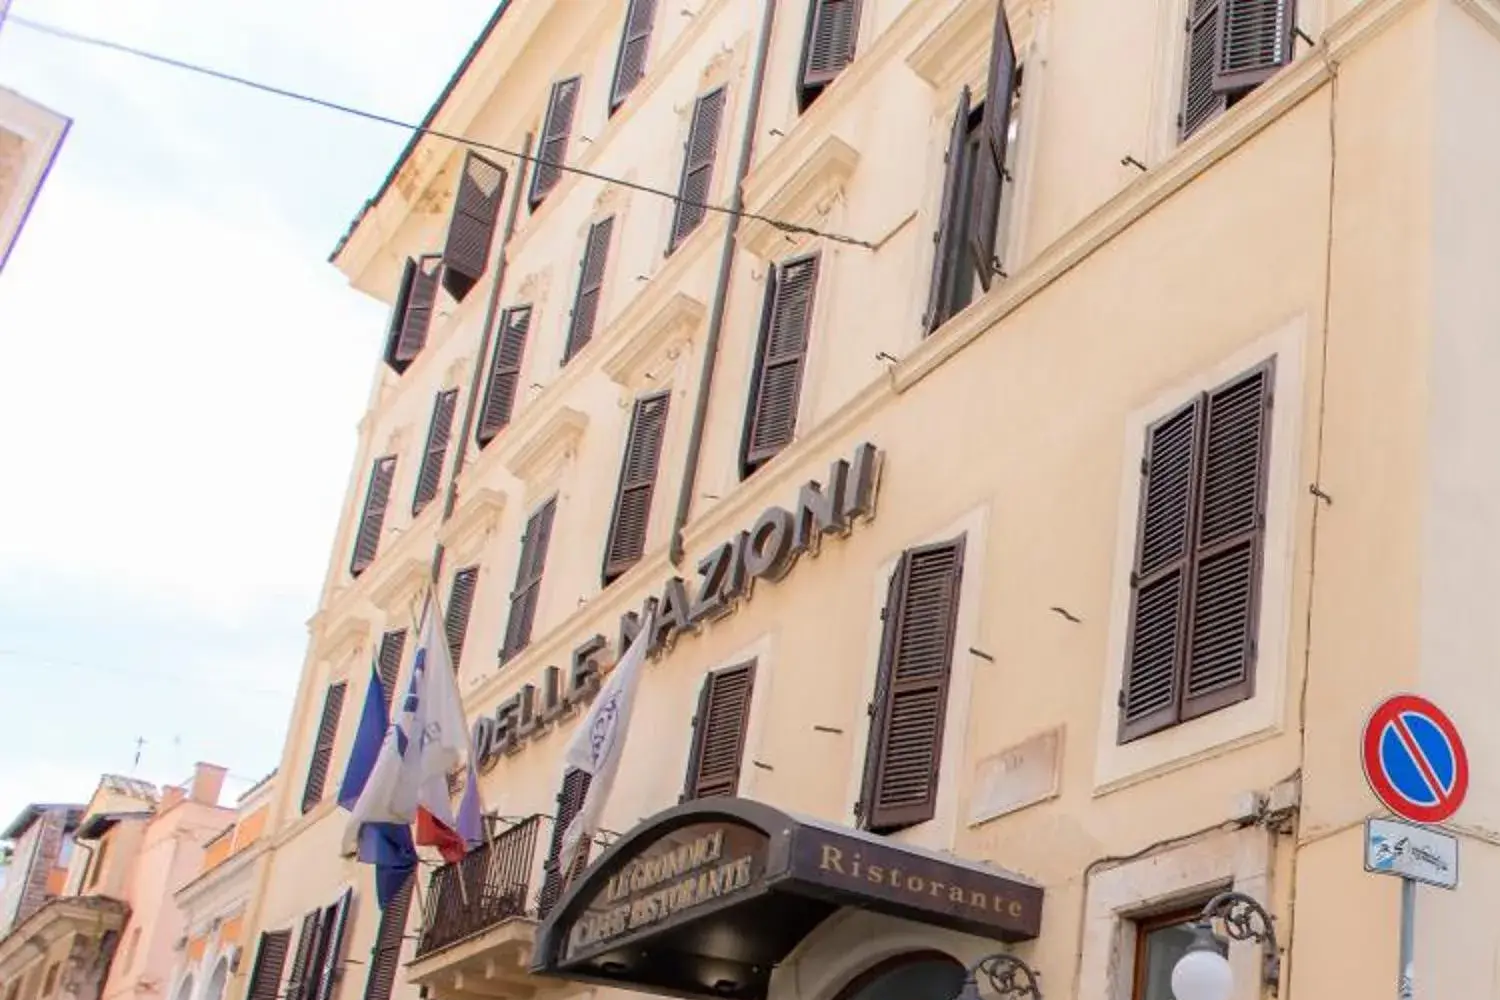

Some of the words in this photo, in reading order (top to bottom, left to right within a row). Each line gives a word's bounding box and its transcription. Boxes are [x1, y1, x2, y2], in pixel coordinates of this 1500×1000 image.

[473, 633, 607, 769] DELLE
[616, 441, 881, 662] NAZIONI
[819, 844, 1023, 919] Ristorante
